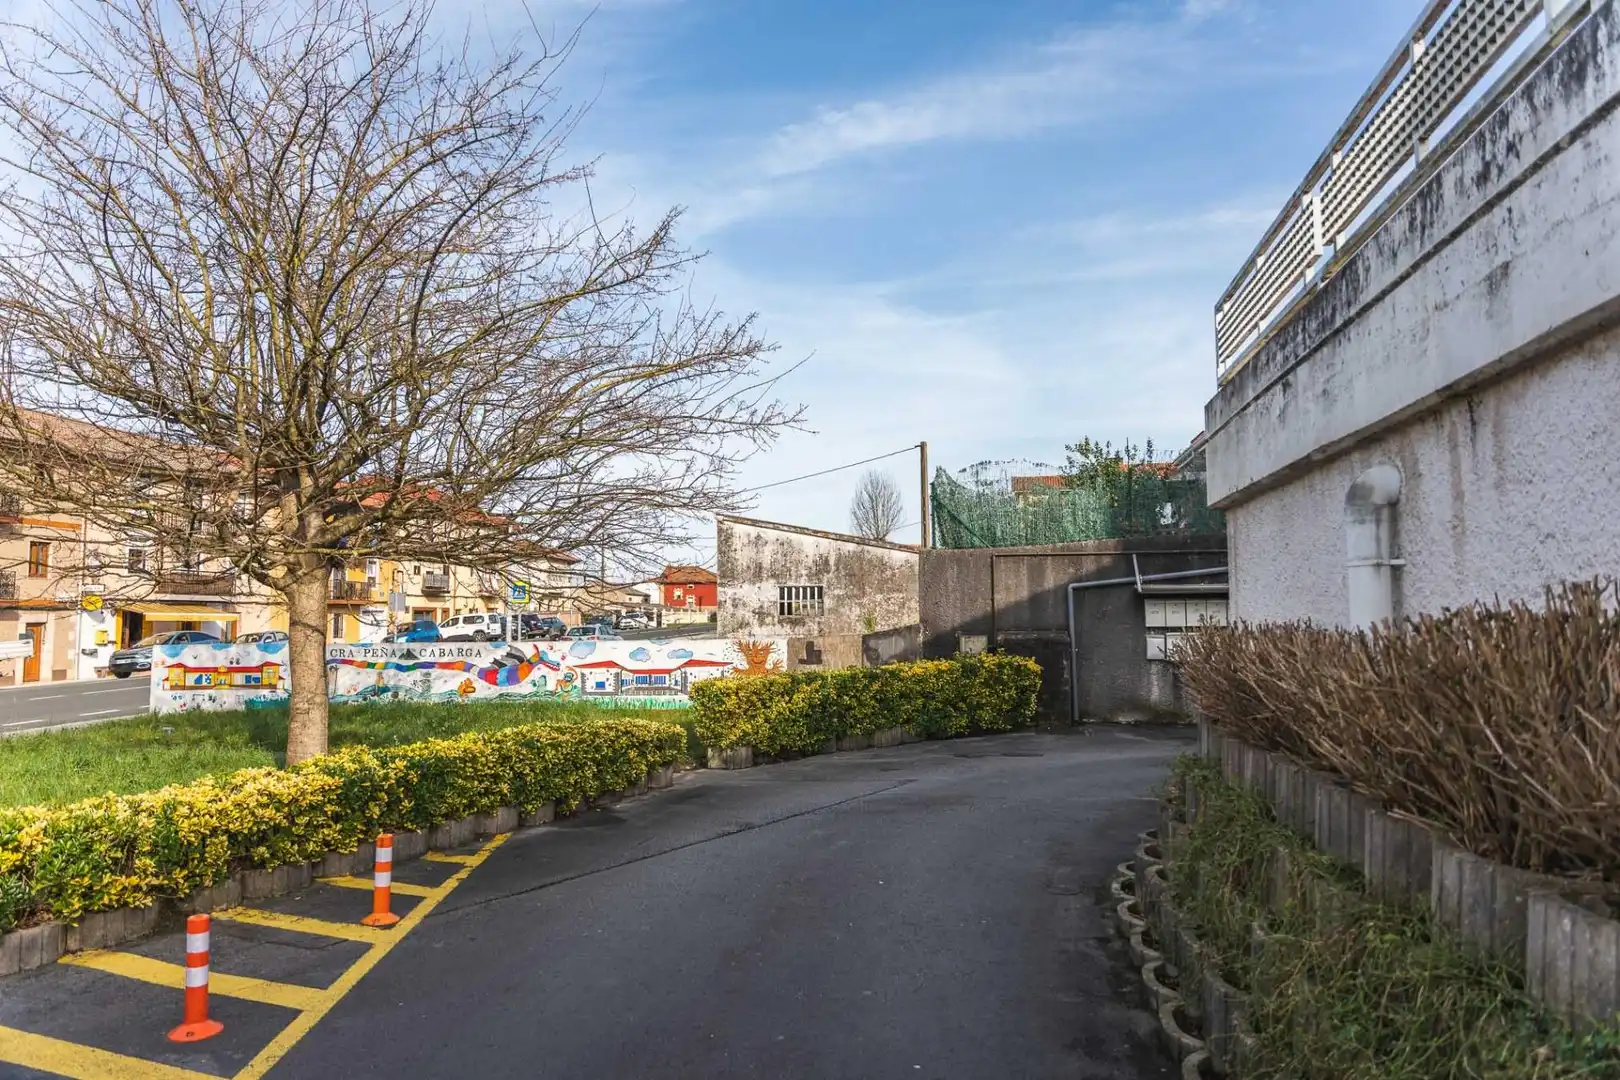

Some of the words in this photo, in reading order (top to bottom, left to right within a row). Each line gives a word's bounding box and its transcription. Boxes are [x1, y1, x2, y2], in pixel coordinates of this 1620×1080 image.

[330, 648, 354, 658] CRA
[363, 646, 397, 658] PEÑA
[419, 647, 482, 658] CABARGA
